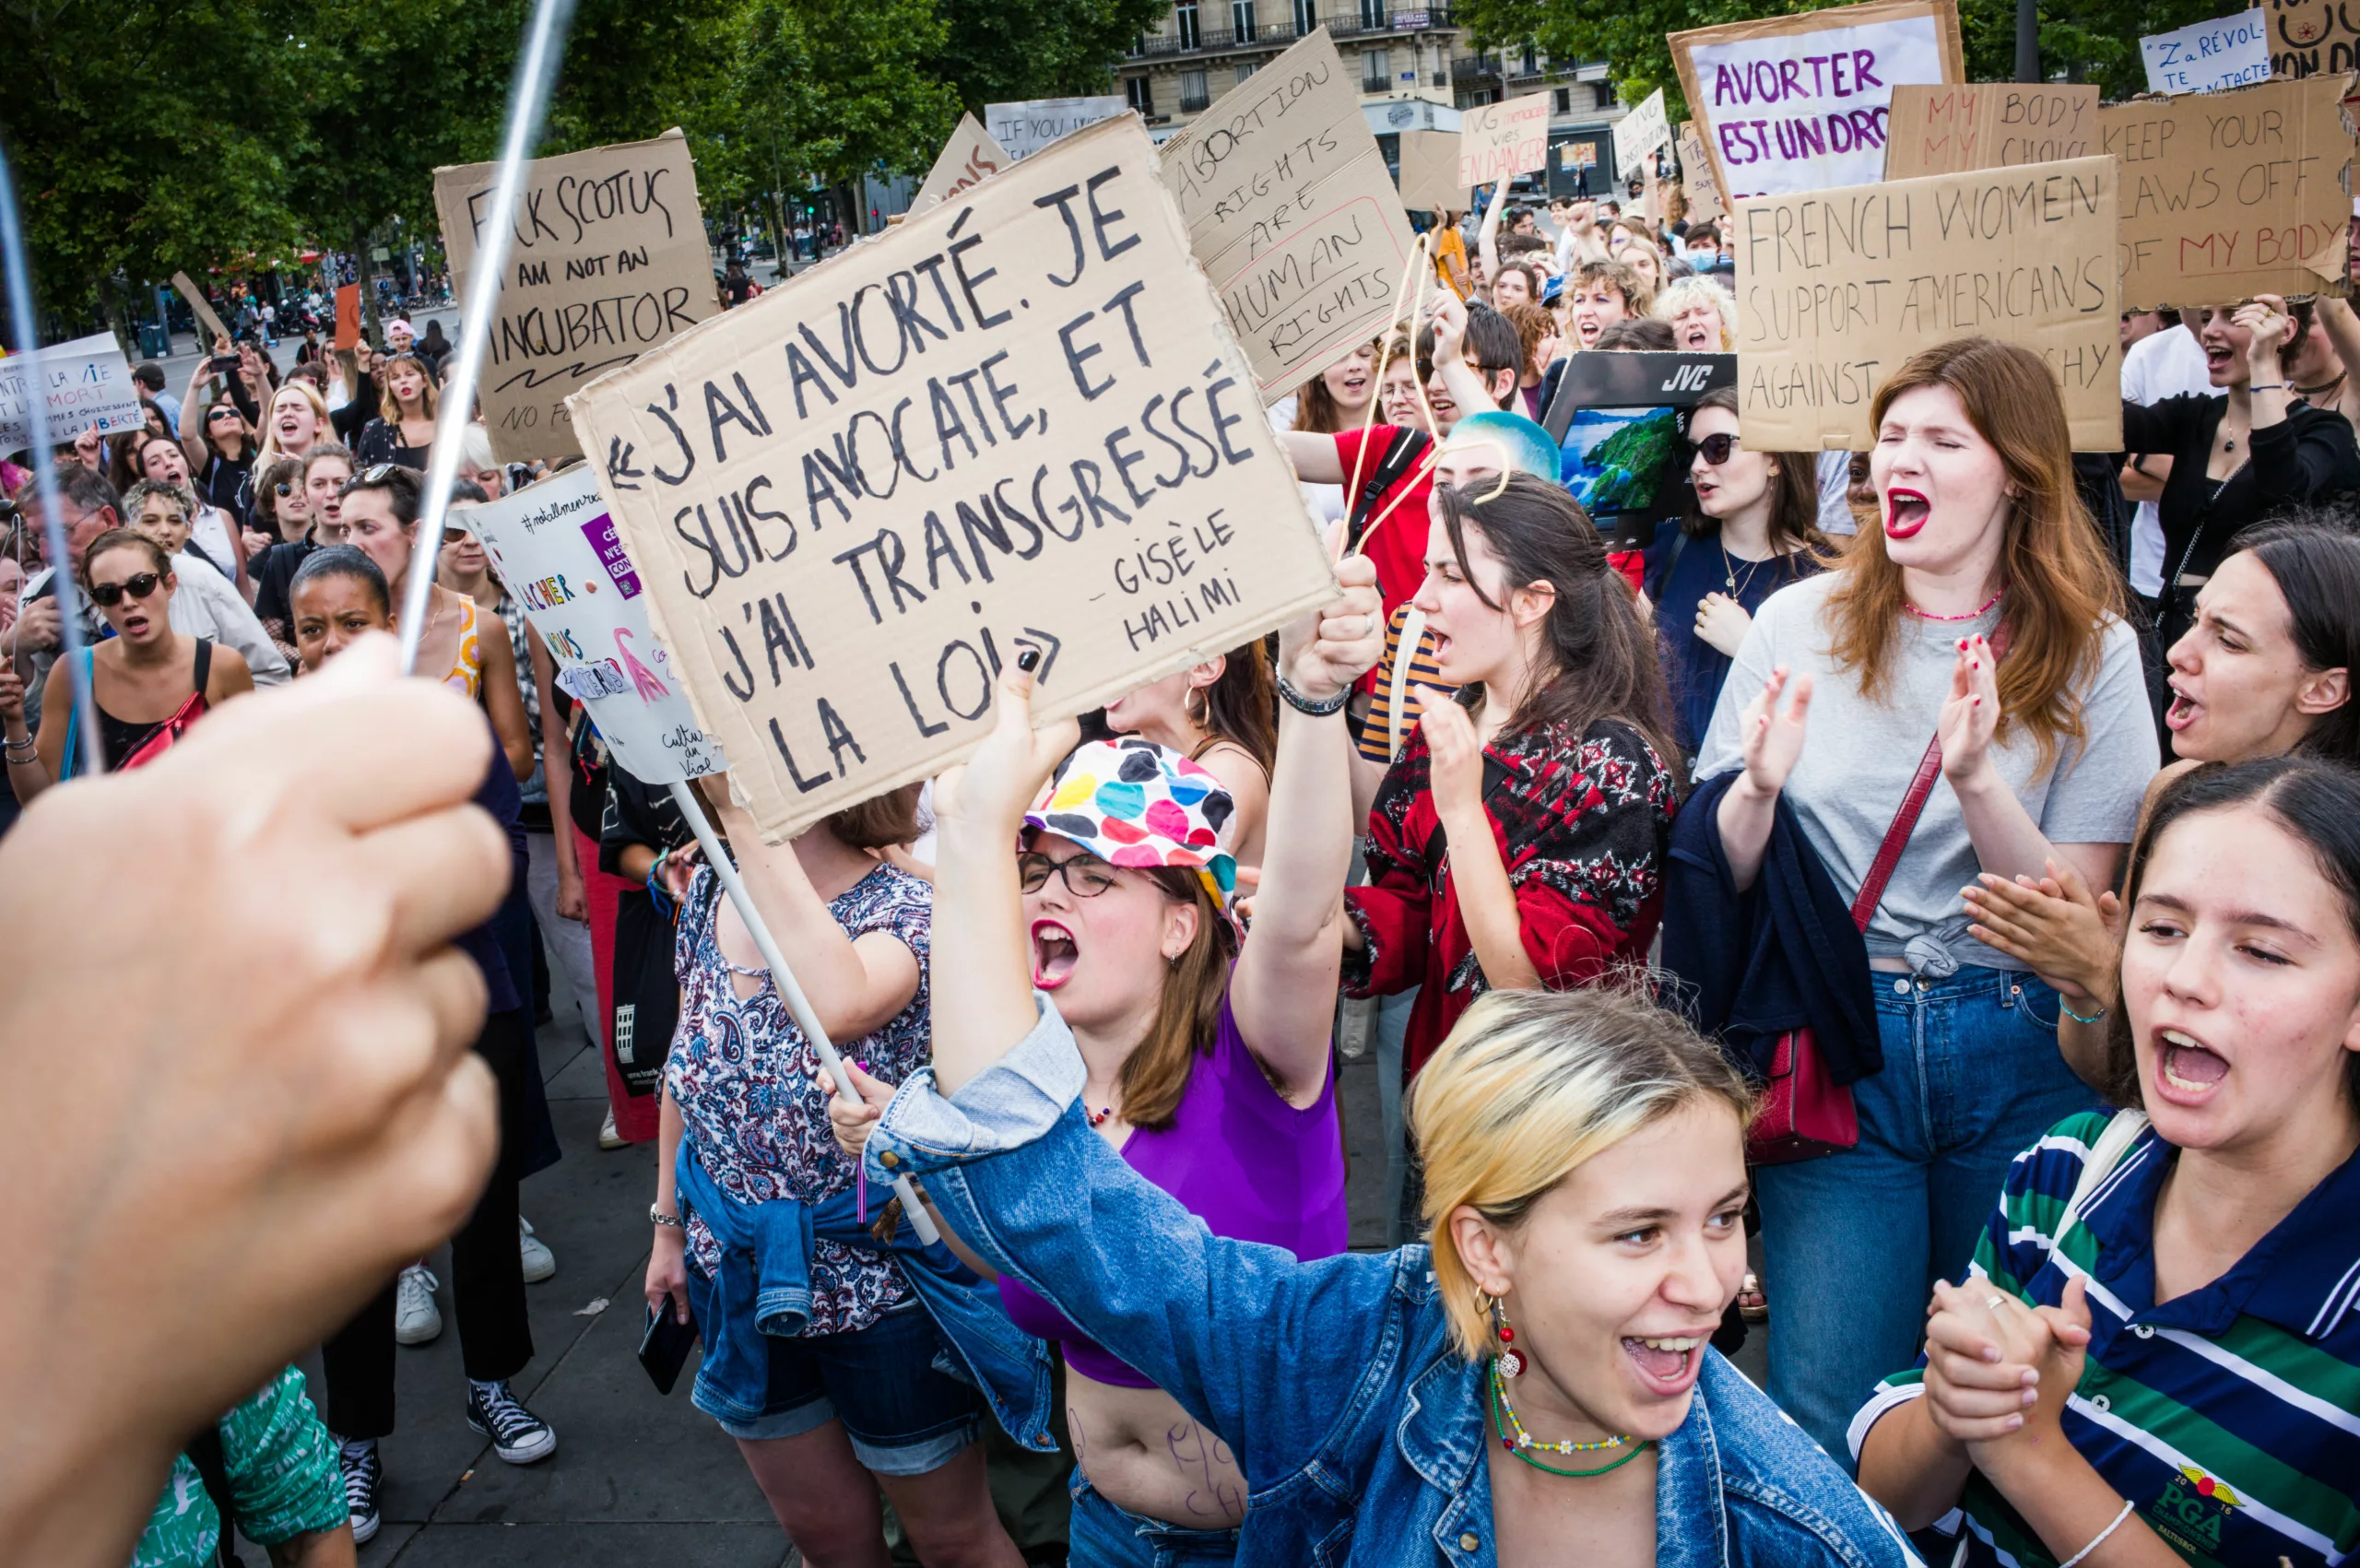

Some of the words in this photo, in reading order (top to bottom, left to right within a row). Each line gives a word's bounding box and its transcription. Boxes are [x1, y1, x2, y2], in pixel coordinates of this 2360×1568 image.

[1715, 49, 1884, 107] AVORTER
[998, 119, 1023, 141] IF
[1030, 117, 1064, 138] YOU
[1175, 60, 1330, 214] ABORTION
[1465, 105, 1498, 135] IVG
[1718, 119, 1770, 166] EST
[1775, 112, 1826, 161] UN
[1929, 92, 1976, 126] MY
[2000, 92, 2088, 135] BODY
[2102, 120, 2176, 163] KEEP
[2206, 110, 2283, 150] YOUR
[1214, 128, 1339, 223] RIGHTS
[1458, 153, 1481, 187] EN
[1487, 137, 1546, 182] DANGER
[1924, 132, 1976, 170] MY
[2237, 157, 2319, 205] OFF
[467, 187, 559, 249] FCK
[558, 168, 673, 244] SCOTUS
[1250, 181, 1315, 262] ARE
[1748, 194, 1912, 276] FRENCH
[1936, 173, 2100, 242] WOMEN
[518, 261, 551, 288] AM
[566, 254, 611, 281] NOT
[618, 245, 648, 275] AN
[2180, 231, 2239, 272] MY
[2258, 220, 2343, 265] BODY
[784, 206, 1032, 422] AVORTÉ.
[1033, 164, 1143, 289] JE
[1223, 214, 1363, 337] HUMAN
[488, 287, 699, 365] INCUBATOR
[1269, 267, 1391, 357] RIGHTS
[1749, 278, 1892, 343] SUPPORT
[46, 383, 106, 407] MORT
[48, 371, 68, 388] LA
[1662, 365, 1714, 392] JVC
[1748, 360, 1879, 411] AGAINST
[63, 425, 78, 436] LA
[502, 405, 537, 430] NO
[673, 474, 798, 601] SUIS
[805, 348, 1049, 531] AVOCATE,
[1058, 278, 1151, 402] ET
[720, 590, 815, 703] J'AI
[832, 358, 1255, 625] TRANSGRESSÉ
[513, 574, 575, 611] LACHER
[544, 629, 583, 660] NOUS
[768, 694, 867, 794] LA
[2156, 1481, 2222, 1543] PGA
[2175, 1474, 2188, 1487] 20
[2220, 1503, 2233, 1516] 16
[2152, 1504, 2218, 1550] CHAMPIONSHIP
[2158, 1524, 2198, 1555] BALTUSROL
